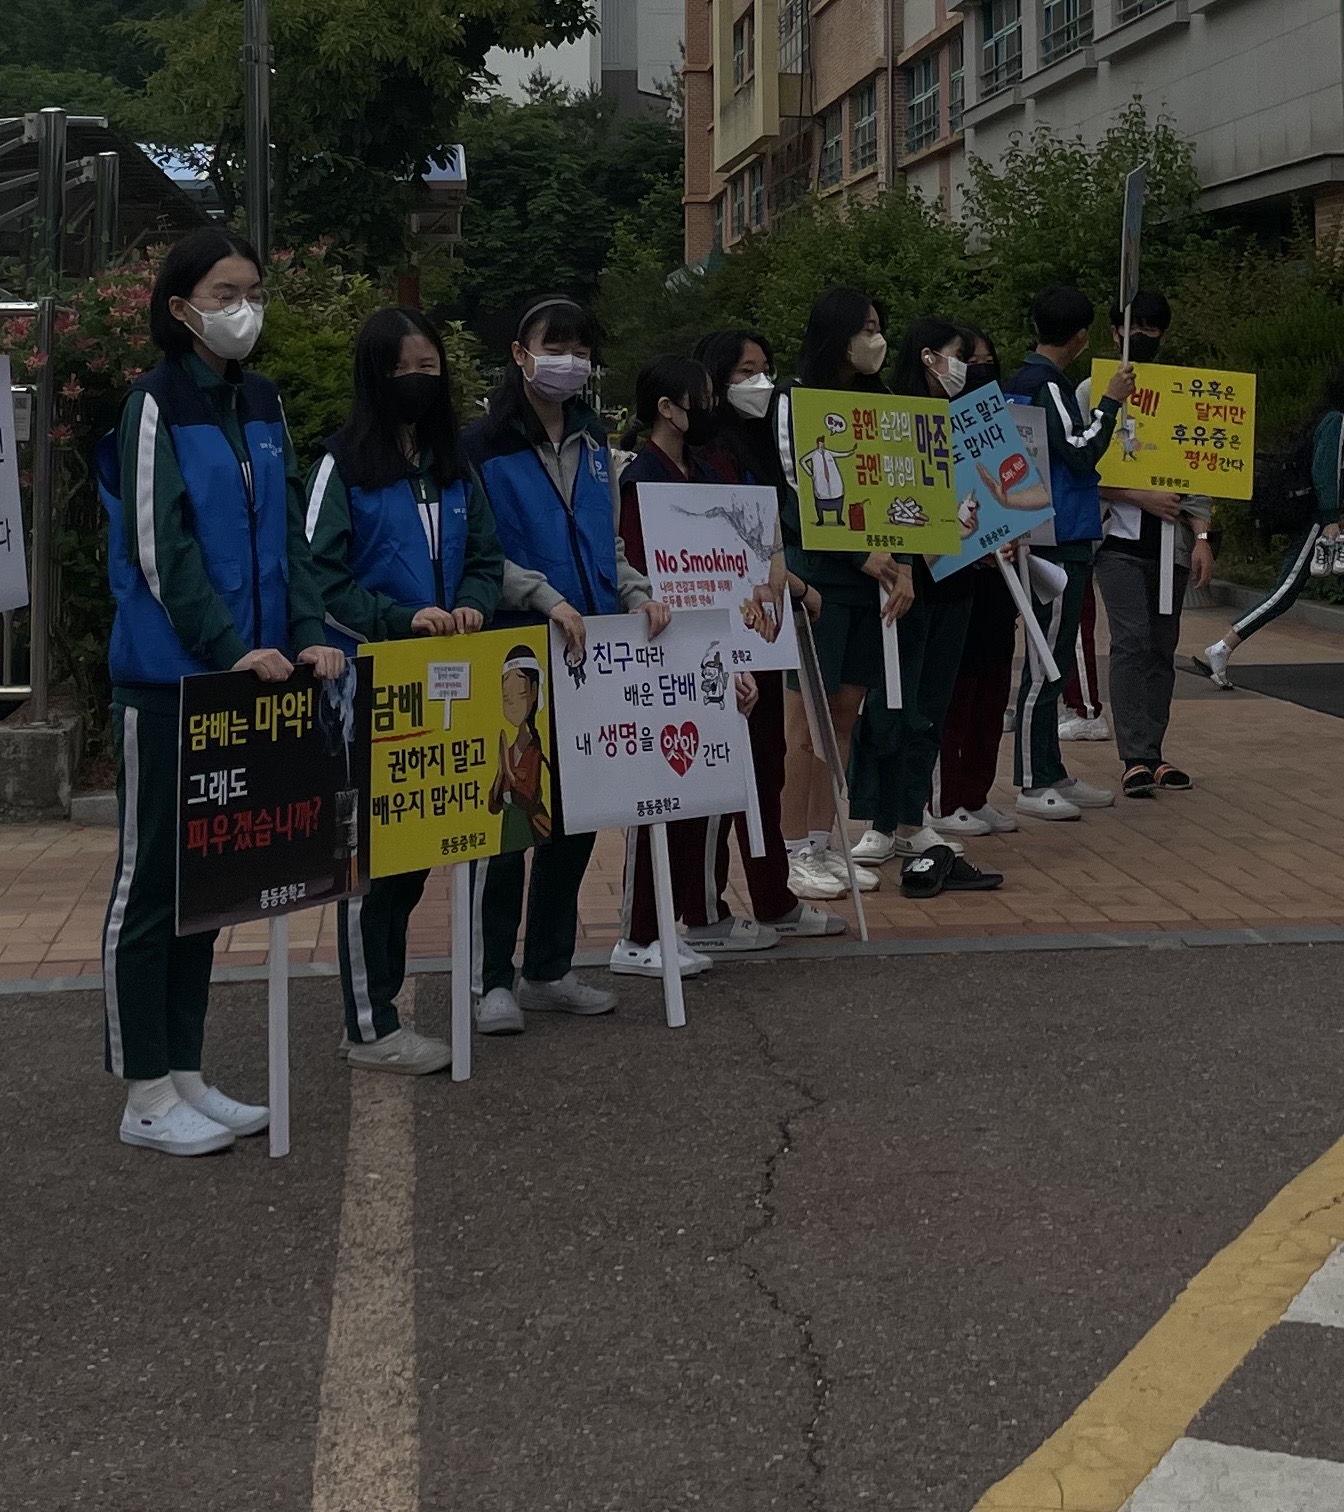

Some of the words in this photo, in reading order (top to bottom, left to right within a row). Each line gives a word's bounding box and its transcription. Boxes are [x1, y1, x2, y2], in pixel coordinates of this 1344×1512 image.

[1171, 382, 1184, 394] 그
[1189, 379, 1236, 401] 유혹은
[852, 407, 878, 440] 흡연!
[880, 410, 912, 442] 순간의
[976, 395, 1004, 424] 말고
[1195, 401, 1246, 425] 달지만
[915, 414, 950, 488] 만족
[964, 423, 1006, 459] 맙시다
[1171, 424, 1241, 450] 후유증은
[856, 454, 882, 486] 금연!
[883, 455, 916, 488] 평생의
[655, 550, 678, 574] No
[680, 548, 749, 577] Smoking!
[373, 682, 423, 732] 담배
[624, 684, 654, 707] 배운
[659, 673, 697, 706] 담배
[189, 710, 249, 751] 담배는
[256, 688, 313, 742] 마약!
[388, 742, 445, 783] 권하지
[451, 738, 486, 775] 말고
[576, 735, 591, 756] 내
[598, 722, 654, 757] 생명을
[703, 742, 731, 767] 간다
[187, 768, 248, 806] 그래도
[372, 789, 424, 825] 배우지
[431, 780, 484, 816] 맙시다.
[636, 797, 681, 816] 풍동중학교
[187, 795, 322, 857] 피우겠습니까?
[440, 832, 487, 855] 풍동중학교
[260, 882, 306, 908] 풍동중학교
